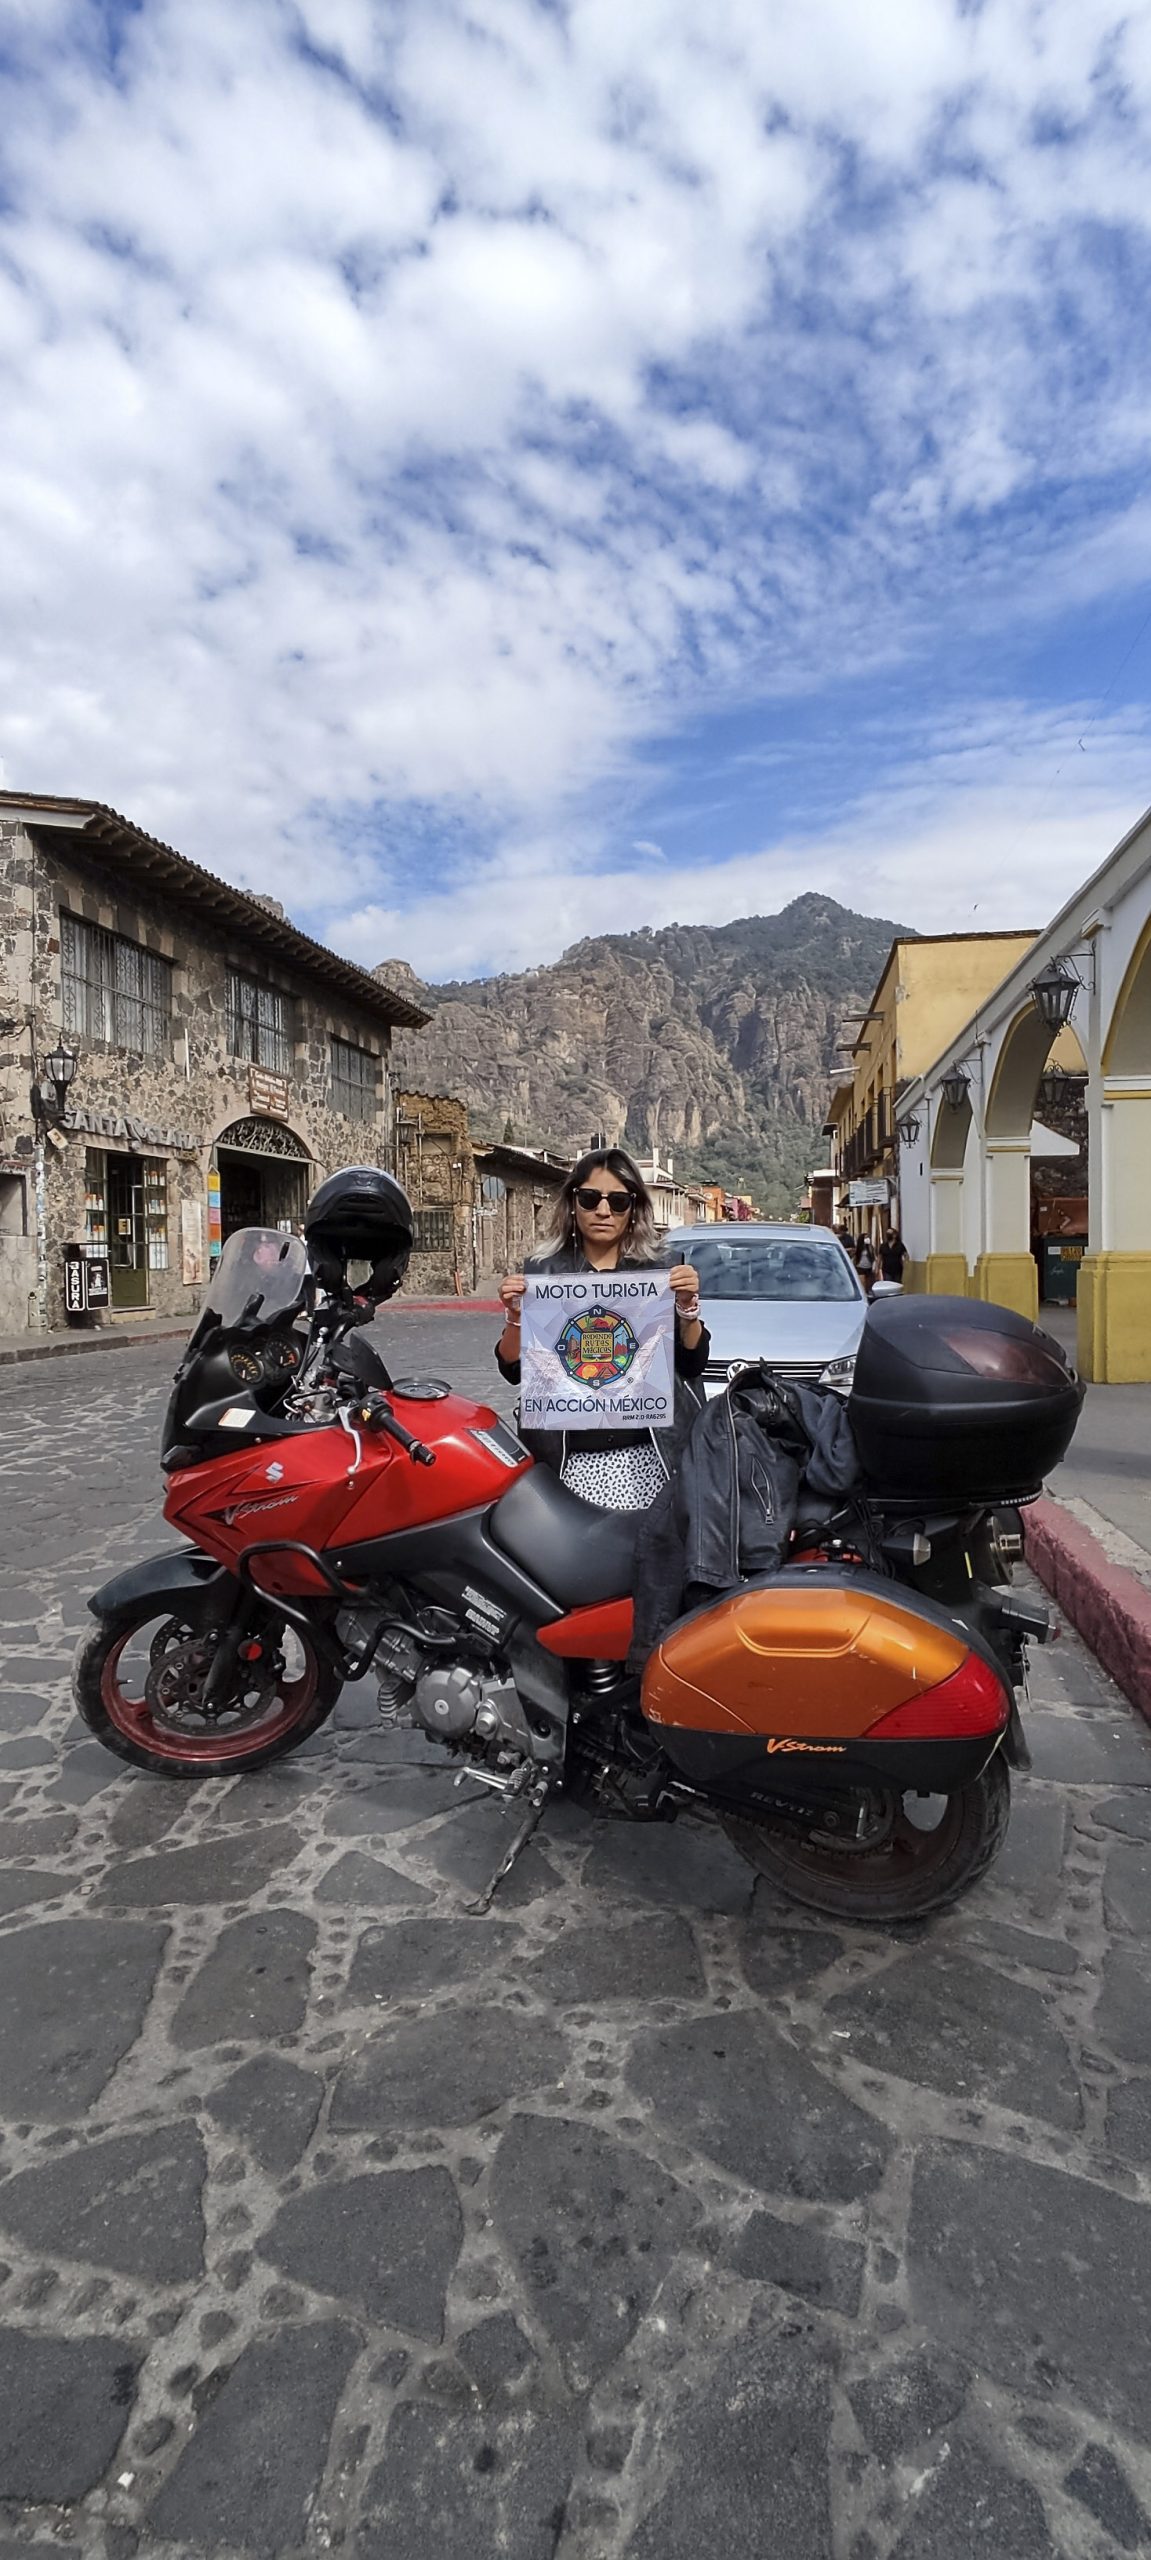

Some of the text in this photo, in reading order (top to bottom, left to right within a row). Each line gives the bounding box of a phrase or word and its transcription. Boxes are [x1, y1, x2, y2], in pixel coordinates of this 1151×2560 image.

[60, 1108, 131, 1138] SANTA
[69, 1261, 80, 1309] BASURA
[535, 1281, 658, 1299] MOTO TURISTA
[525, 1394, 667, 1412] EN ACCIÓN MÉXICO
